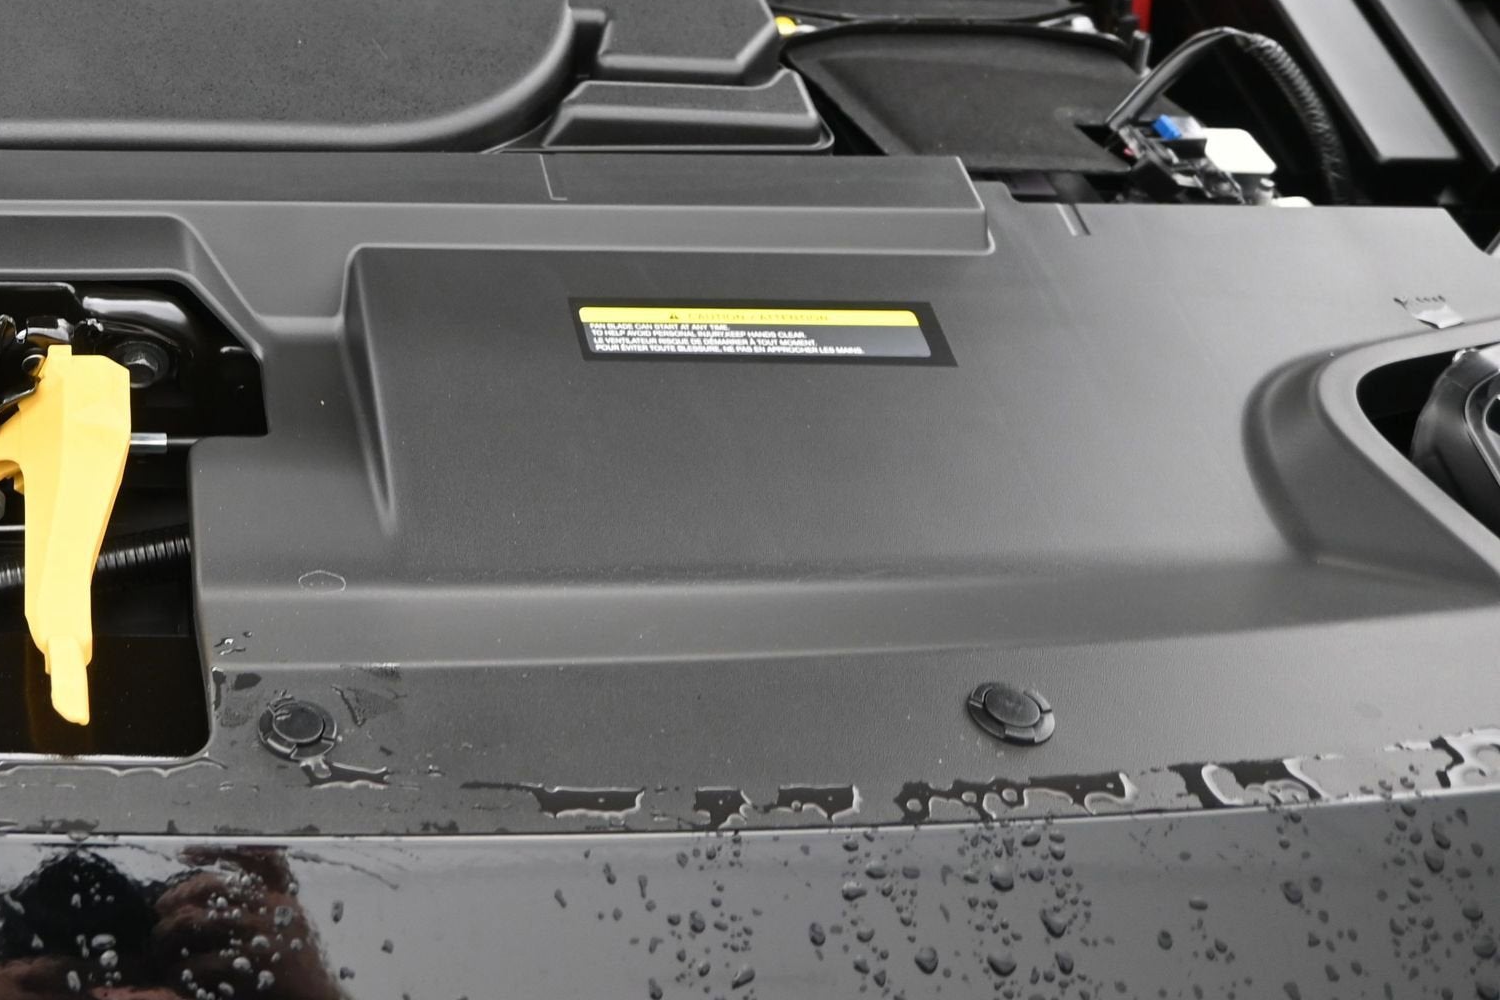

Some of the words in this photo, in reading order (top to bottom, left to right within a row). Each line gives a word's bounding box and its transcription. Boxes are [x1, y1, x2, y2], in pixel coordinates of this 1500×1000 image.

[589, 322, 606, 330] FAN
[607, 322, 634, 330] BLADE
[635, 322, 653, 330] CAN
[680, 323, 691, 331] AT
[692, 323, 709, 331] ANY
[703, 337, 749, 346] DÉMARRER
[621, 344, 649, 352] ÉVITER
[767, 346, 820, 354] APPROCHER
